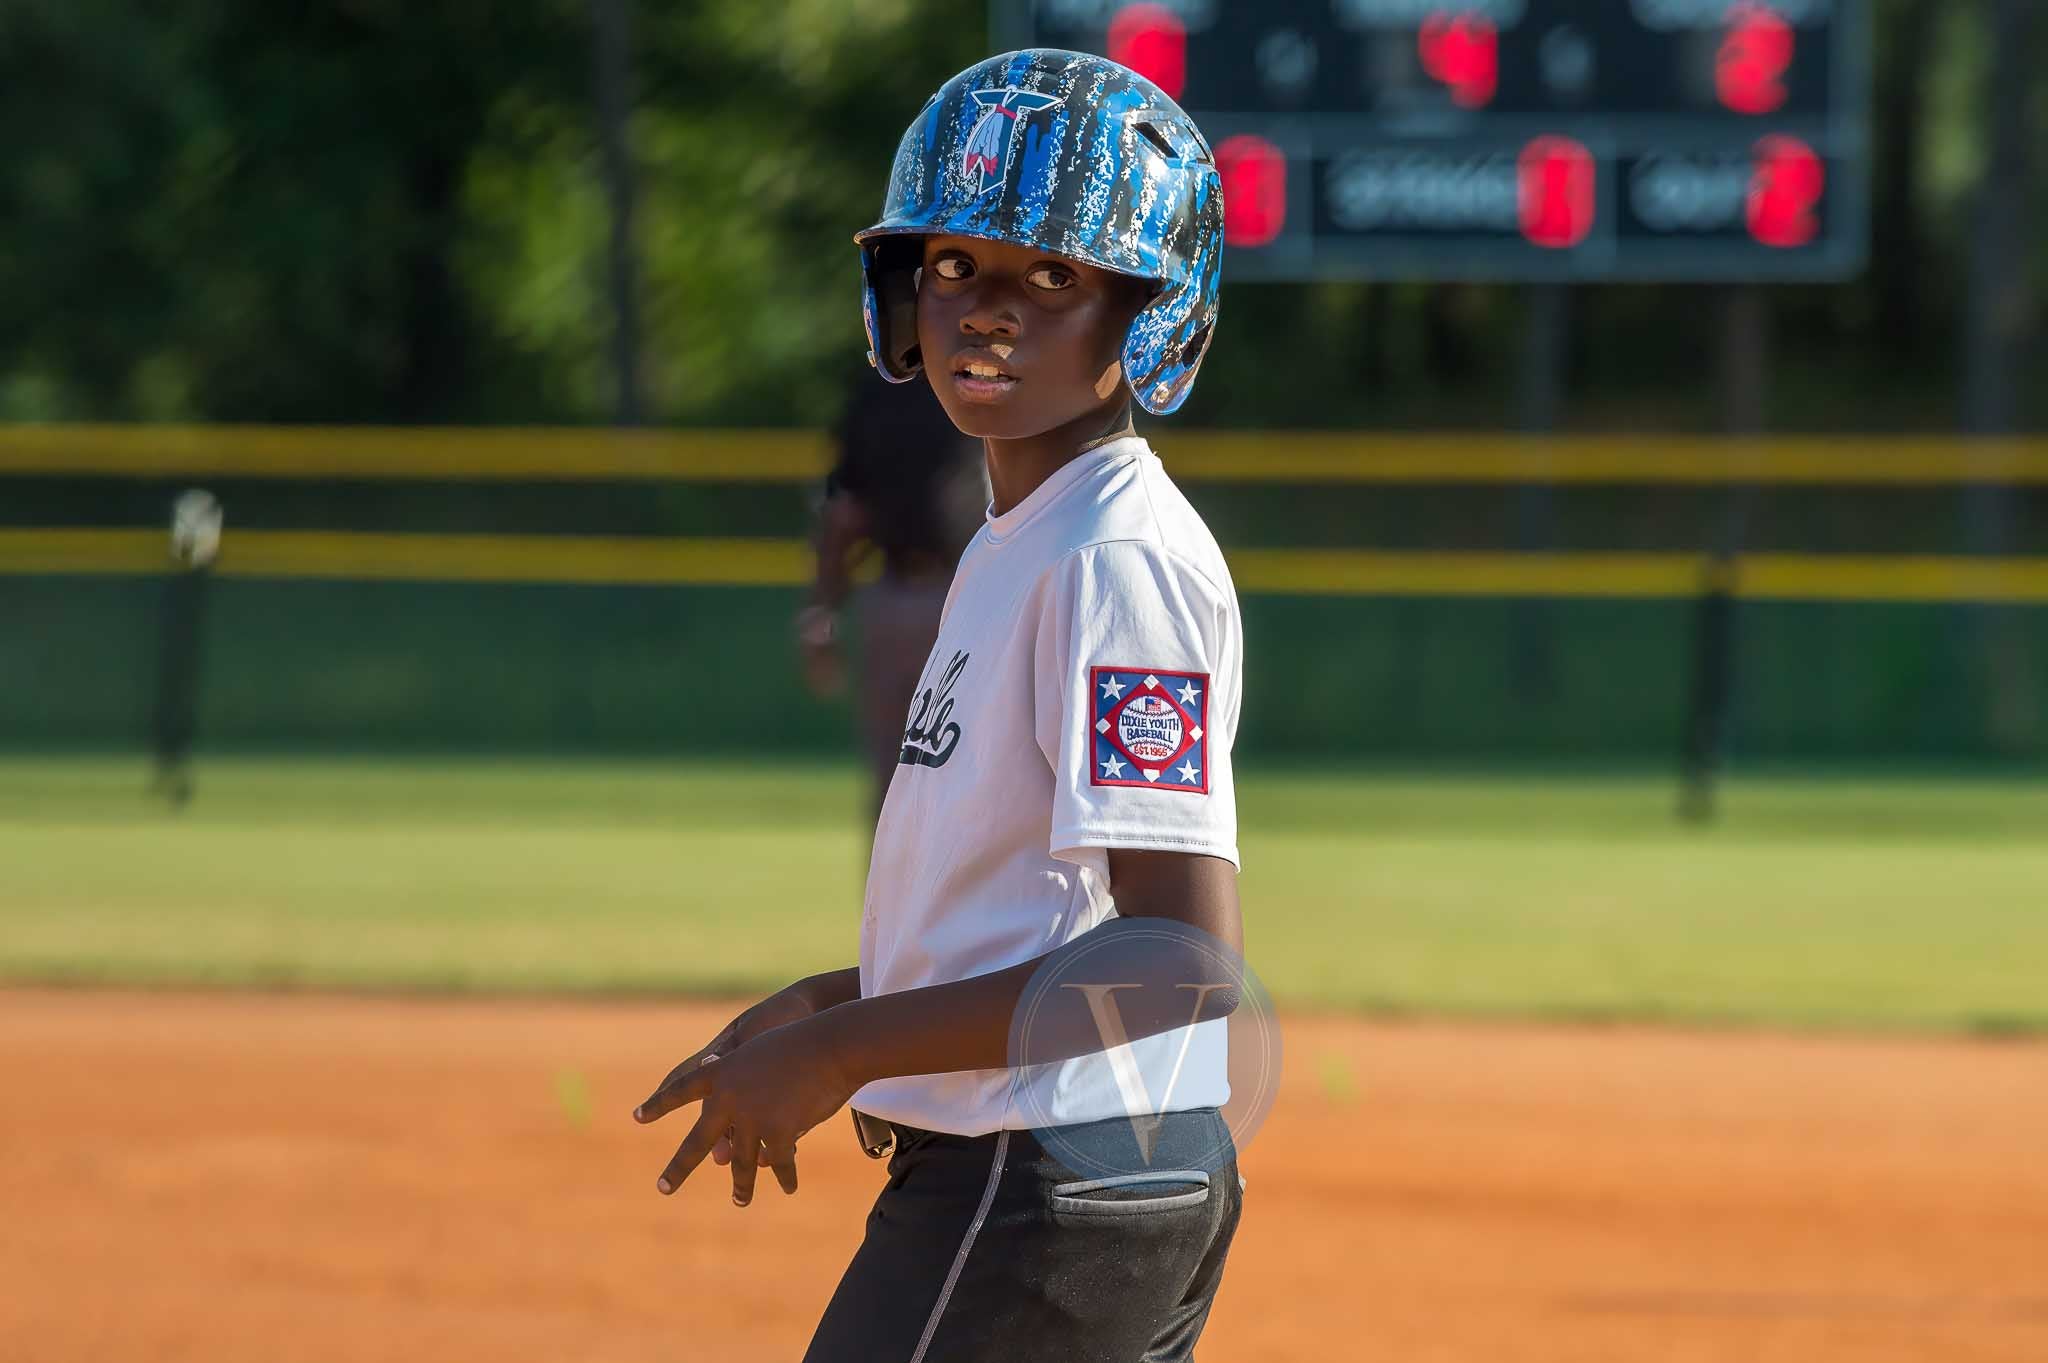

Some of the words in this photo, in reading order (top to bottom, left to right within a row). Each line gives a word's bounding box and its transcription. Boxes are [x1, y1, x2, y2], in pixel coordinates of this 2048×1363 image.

[1121, 715, 1147, 728] DIXIE
[1148, 718, 1179, 731] YOUTH
[1127, 728, 1173, 743] BASEBALL
